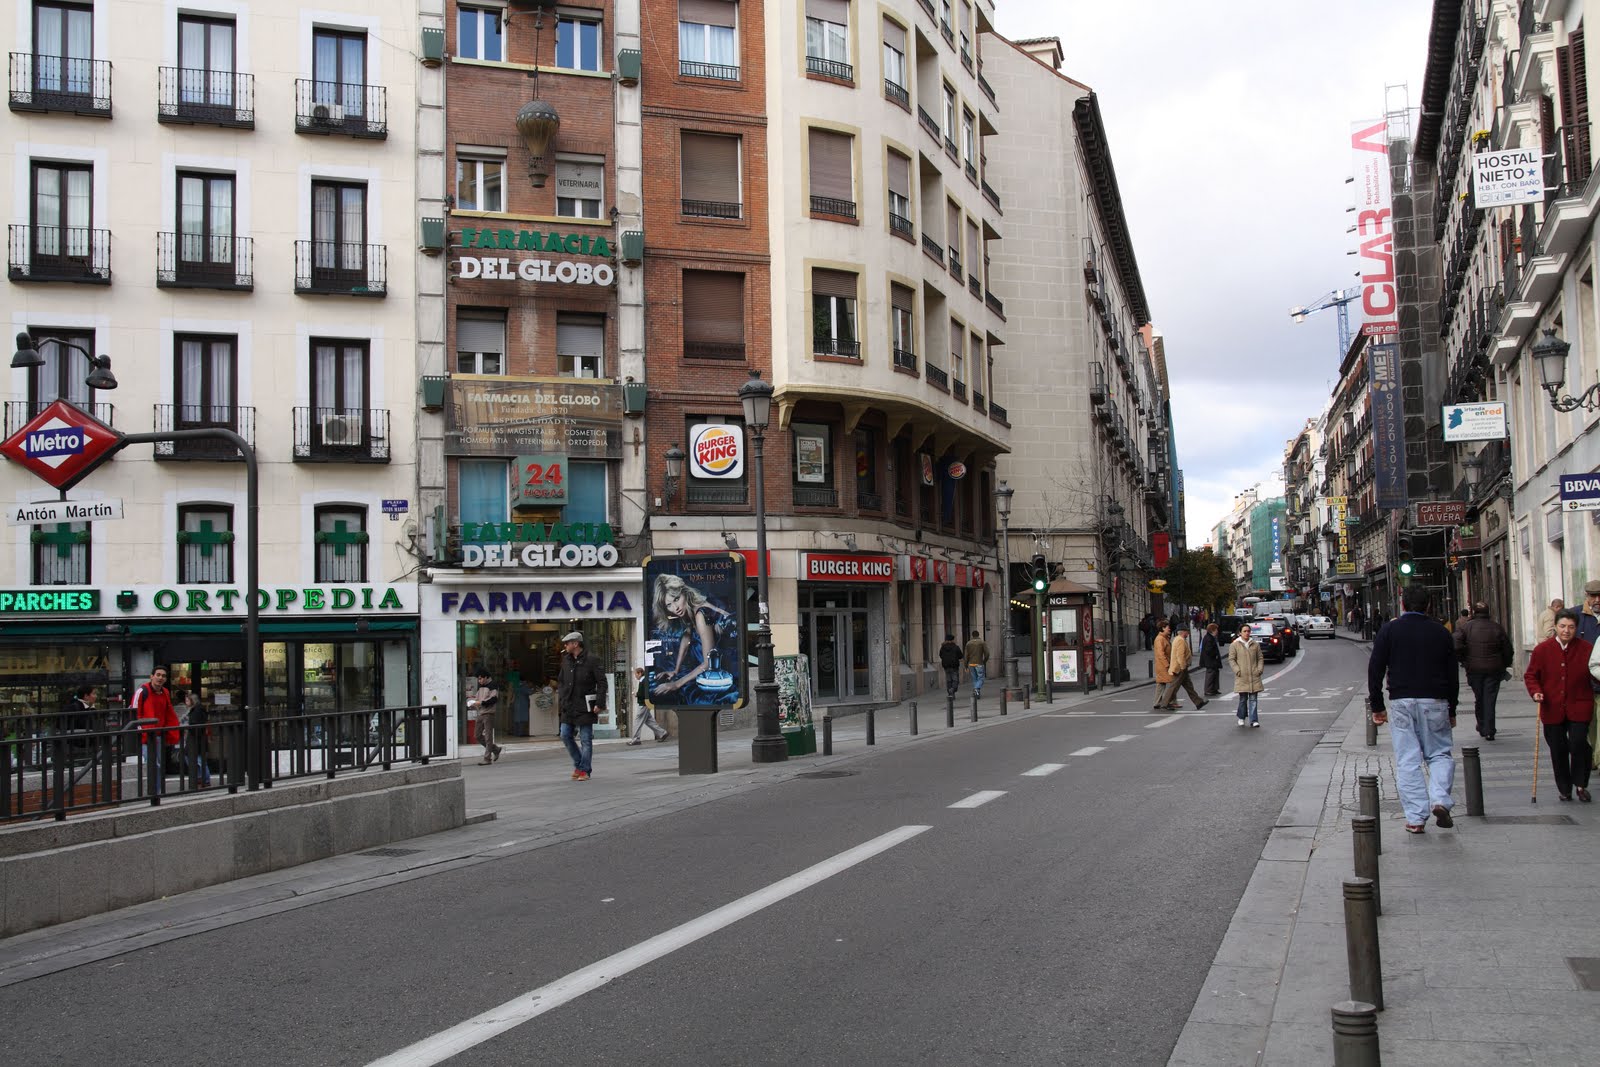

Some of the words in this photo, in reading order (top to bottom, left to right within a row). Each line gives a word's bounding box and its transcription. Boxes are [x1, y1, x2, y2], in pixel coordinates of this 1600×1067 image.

[1478, 152, 1538, 169] HOSTAL
[558, 178, 600, 189] VETERINARIA
[1480, 168, 1525, 183] NIETO
[1519, 179, 1541, 187] BAÑO
[460, 228, 612, 257] FARMACIA
[1358, 207, 1396, 317] CLAR
[459, 256, 516, 281] DEL
[518, 258, 614, 287] GLOBO
[1365, 324, 1397, 334] clar.es
[1373, 350, 1388, 381] MEI
[467, 392, 531, 404] FARMACIA
[534, 393, 558, 405] DEL
[559, 394, 601, 406] GLOBO
[1386, 393, 1394, 420] 902
[493, 417, 561, 426] ESPECIALIDAD
[463, 426, 504, 434] FORMULAS
[507, 427, 556, 436] MAGISTRALES
[565, 429, 607, 437] COSMETICA
[1388, 423, 1396, 442] 20
[30, 433, 80, 453] Metro
[459, 436, 508, 445] HOMEOPATIA
[515, 437, 561, 446] VETERINARIA
[568, 438, 609, 447] ORTOPEDIA
[697, 435, 736, 453] BURGER
[699, 444, 737, 465] KING
[1390, 445, 1397, 464] 30
[526, 463, 563, 486] 24
[1390, 467, 1398, 485] 77
[523, 488, 565, 498] HORAS
[1564, 479, 1600, 493] BBVA
[17, 507, 57, 521] Antón
[66, 503, 112, 518] Martín
[1446, 504, 1462, 512] BAR
[1423, 514, 1435, 522] LA
[462, 521, 615, 543] FARMACIA
[462, 544, 518, 568] DEL
[521, 544, 619, 567] GLOBO
[681, 563, 708, 571] VELVET
[710, 561, 733, 569] HOUR
[811, 559, 859, 575] BURGER
[862, 561, 891, 576] KING
[0, 592, 93, 611] PARCHES
[153, 587, 403, 612] ORTOPEDIA
[441, 590, 632, 613] FARMACIA
[46, 655, 111, 673] PLAZA
